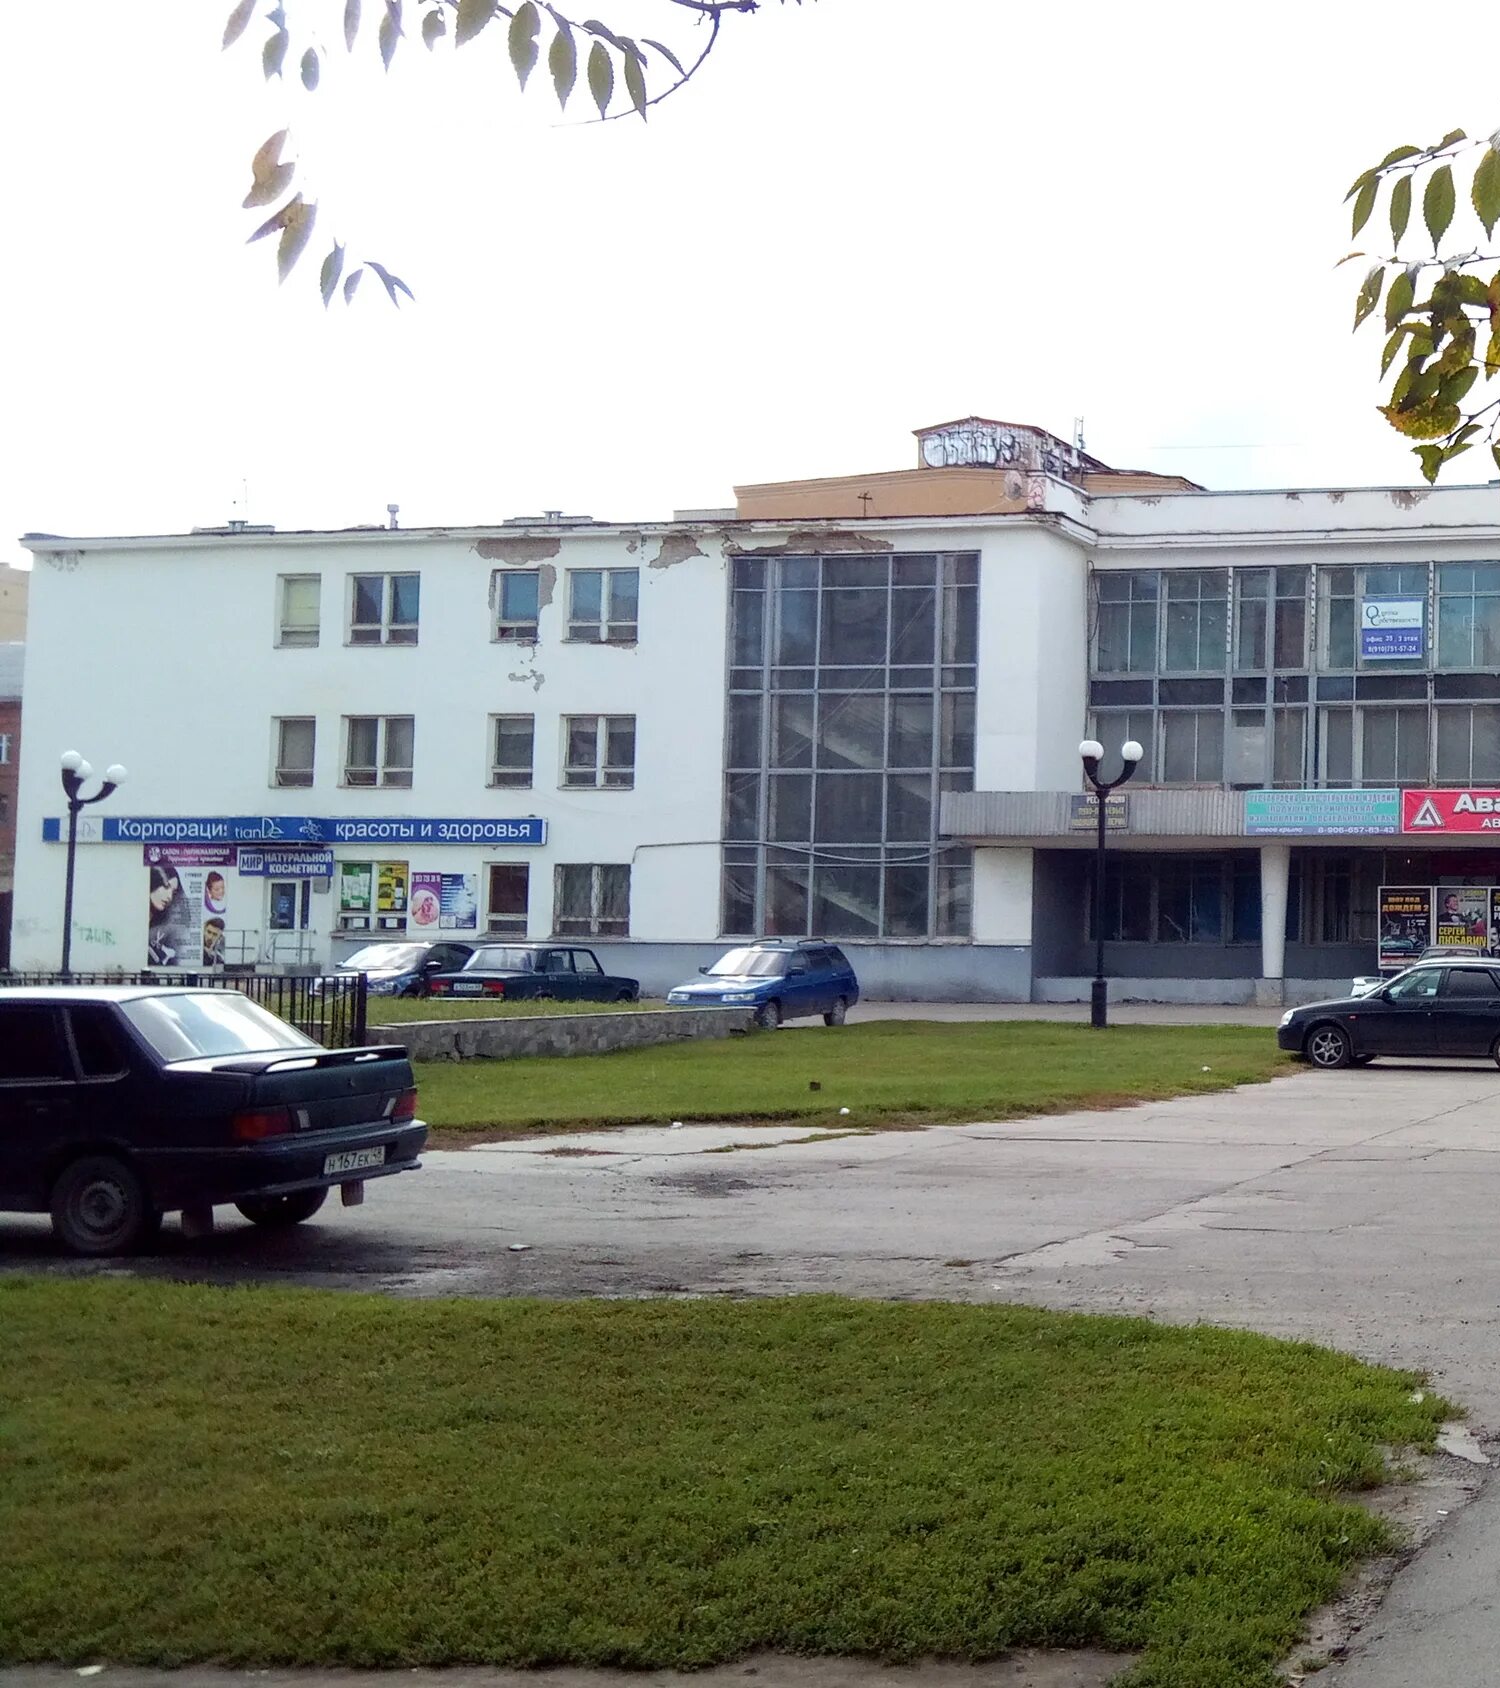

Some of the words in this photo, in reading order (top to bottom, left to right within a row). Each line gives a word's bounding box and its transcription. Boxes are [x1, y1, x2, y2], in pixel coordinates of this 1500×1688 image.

[234, 817, 285, 839] tianDe
[335, 822, 414, 841] красоты
[420, 824, 432, 837] и
[438, 824, 531, 841] здоровья
[241, 855, 264, 869] МИР
[264, 851, 333, 863] НАТУРАЛЬНОЙ
[269, 863, 327, 874] КОСМЕТИКИ
[1423, 904, 1429, 912] 2
